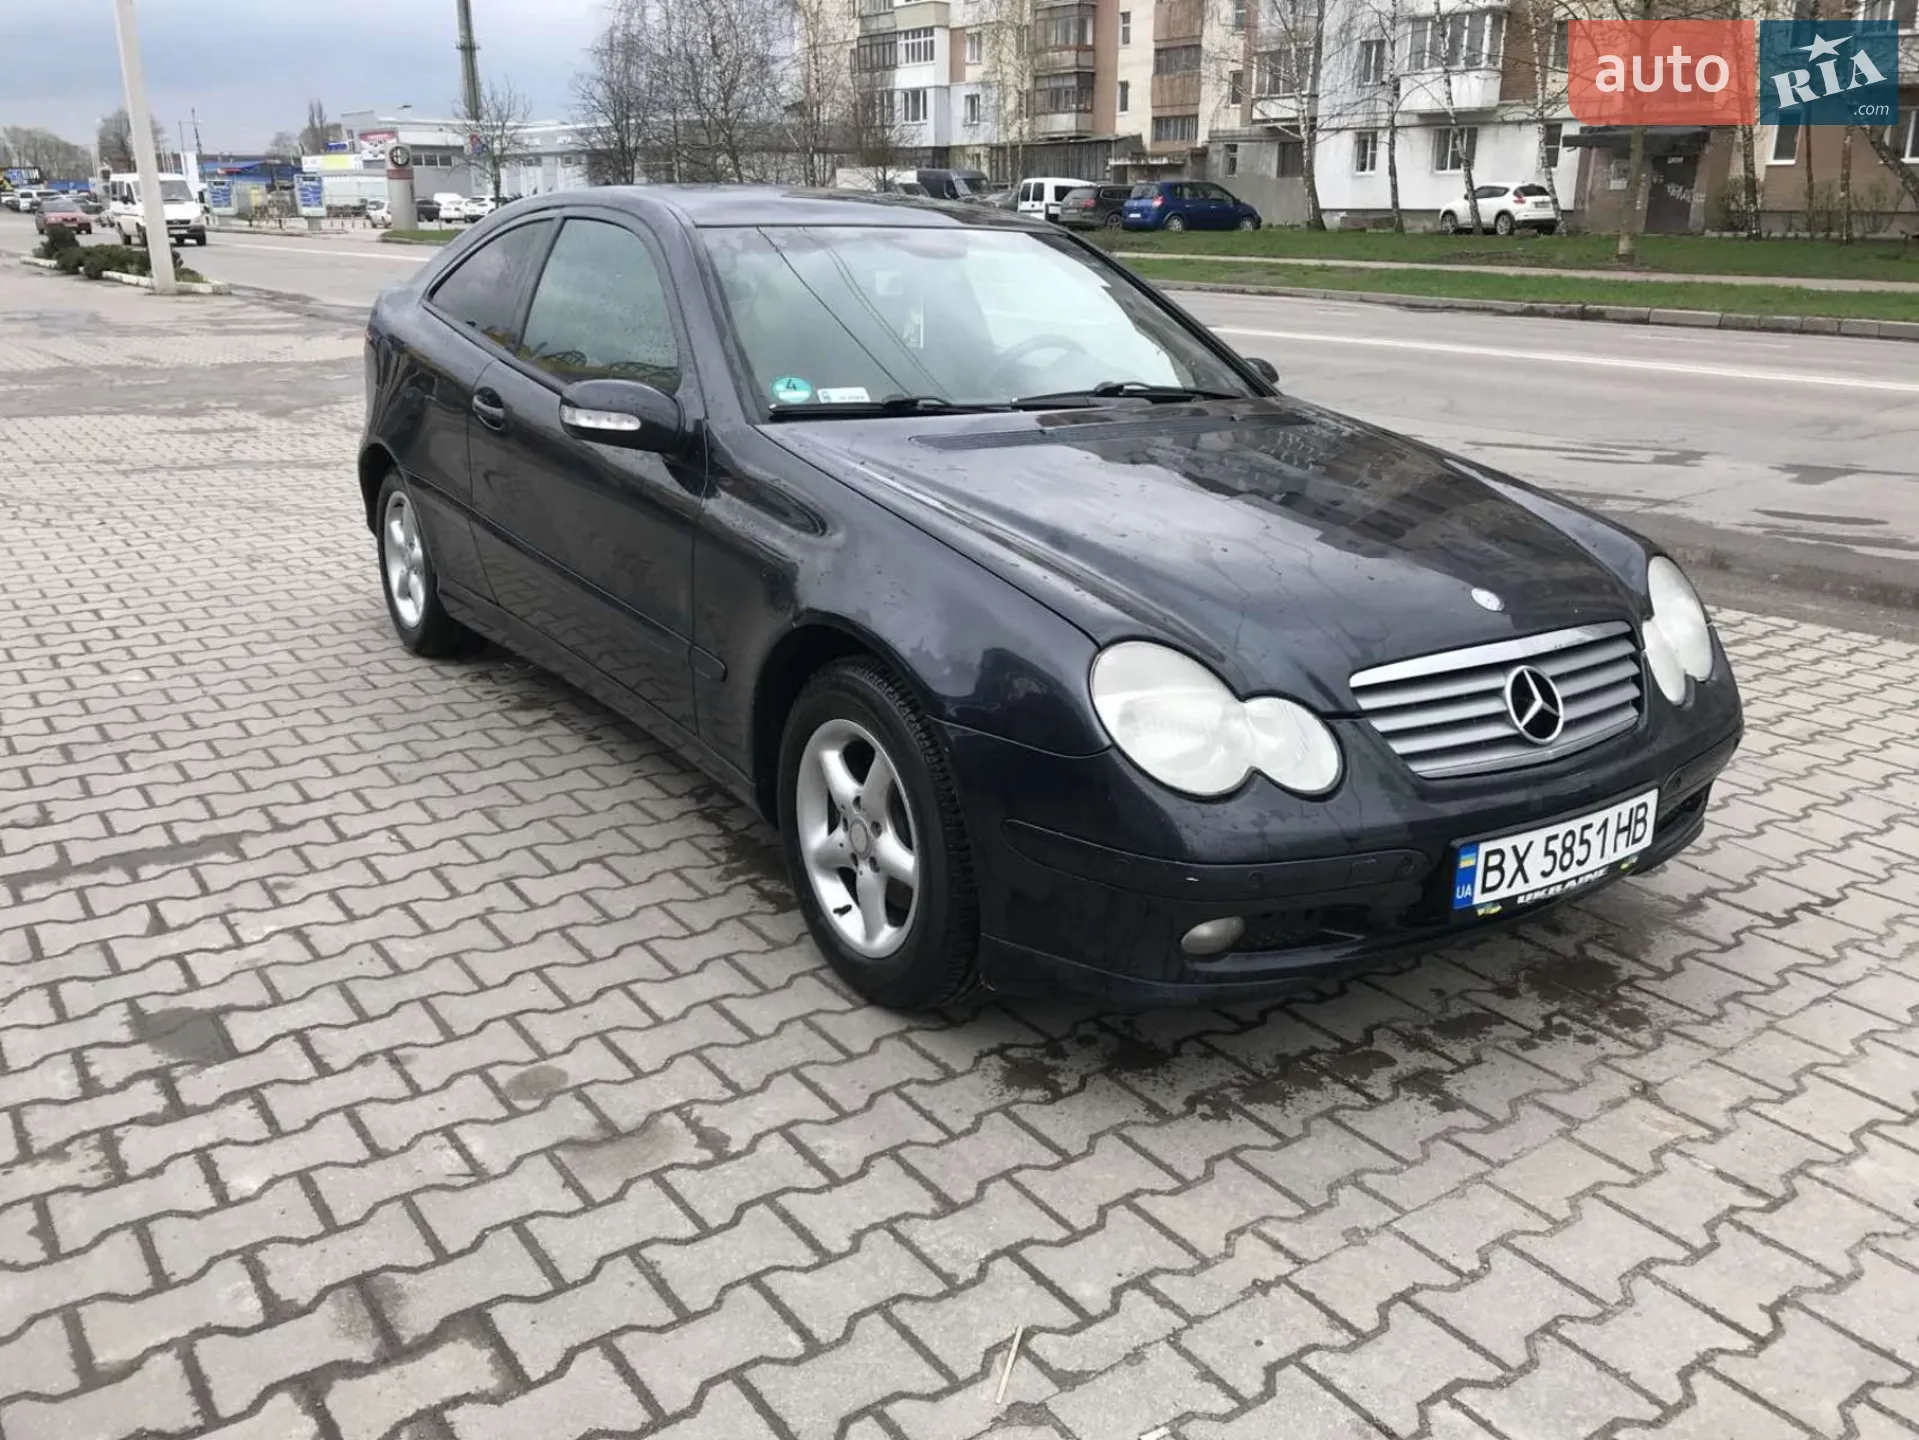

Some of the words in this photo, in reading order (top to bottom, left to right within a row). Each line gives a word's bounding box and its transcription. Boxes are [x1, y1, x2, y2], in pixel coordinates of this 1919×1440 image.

[1481, 840, 1534, 894] BX
[1541, 817, 1610, 878] 5851
[1613, 802, 1648, 853] HB
[1456, 885, 1472, 899] UA
